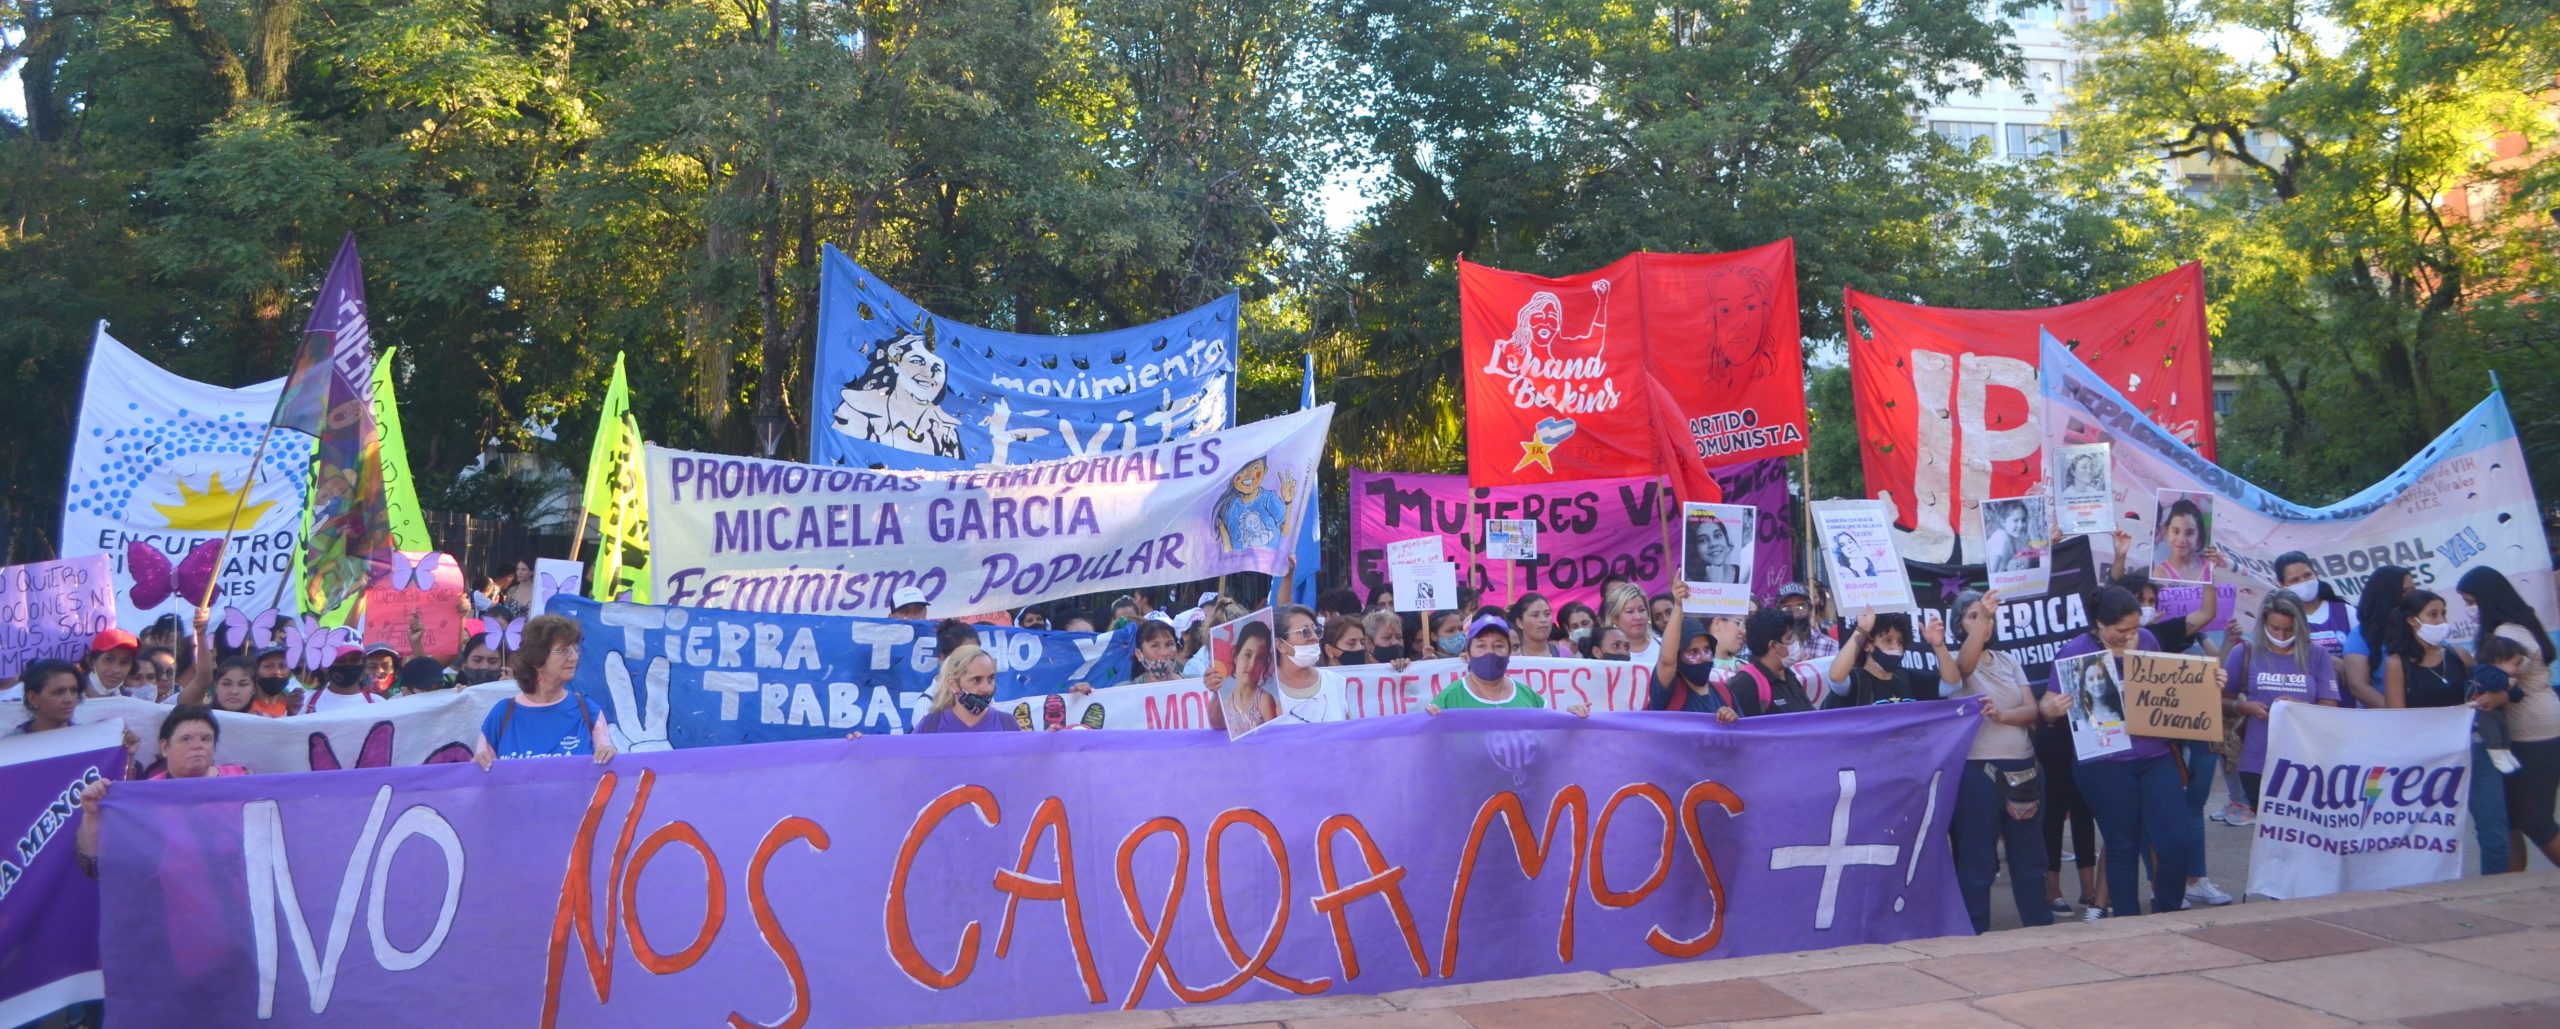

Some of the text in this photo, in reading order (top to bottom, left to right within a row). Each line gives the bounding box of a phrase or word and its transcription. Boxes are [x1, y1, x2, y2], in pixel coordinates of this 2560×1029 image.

[1689, 408, 1758, 437] ARTIDO
[1695, 423, 1802, 459] OMUNISTA
[670, 436, 1223, 504] PROMOTORAS TERRITORIALES
[713, 487, 1101, 554] MICAELA GARCÍA
[2305, 537, 2435, 579] ABORAL
[2436, 525, 2487, 569] YA!
[1068, 630, 1114, 681] Y
[17, 764, 104, 867] MENOS
[2258, 823, 2458, 857] MISIONES/POSADAS
[2262, 800, 2457, 829] FEMINISMO POPULAR
[242, 784, 467, 1021] NO
[539, 766, 832, 1029] NOS
